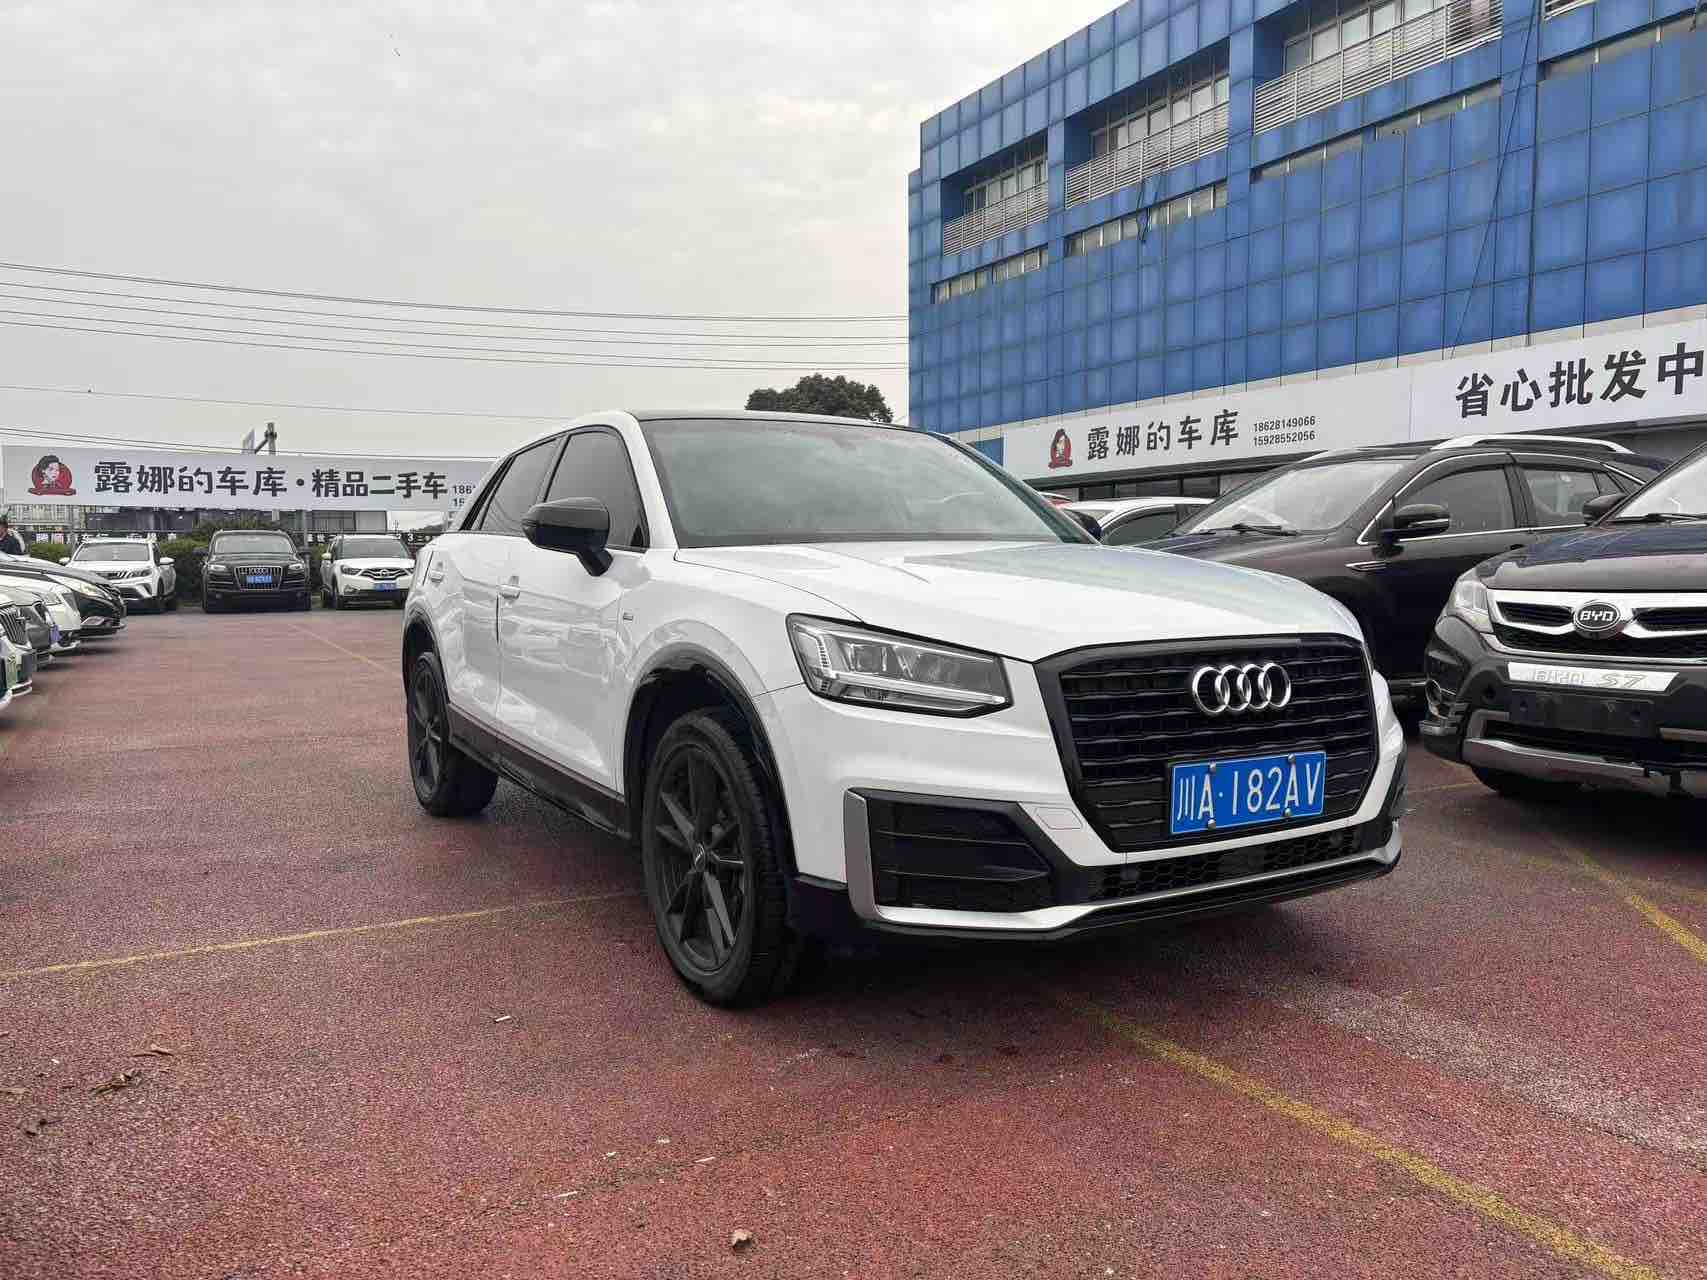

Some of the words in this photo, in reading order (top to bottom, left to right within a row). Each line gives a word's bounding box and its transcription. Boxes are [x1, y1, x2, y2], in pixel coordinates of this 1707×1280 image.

[1456, 342, 1704, 418] 省心批发中
[1254, 415, 1316, 432] 18628149066
[1087, 409, 1239, 460] 露娜的车库
[1254, 430, 1316, 447] 15928552056
[1580, 610, 1614, 621] BYD
